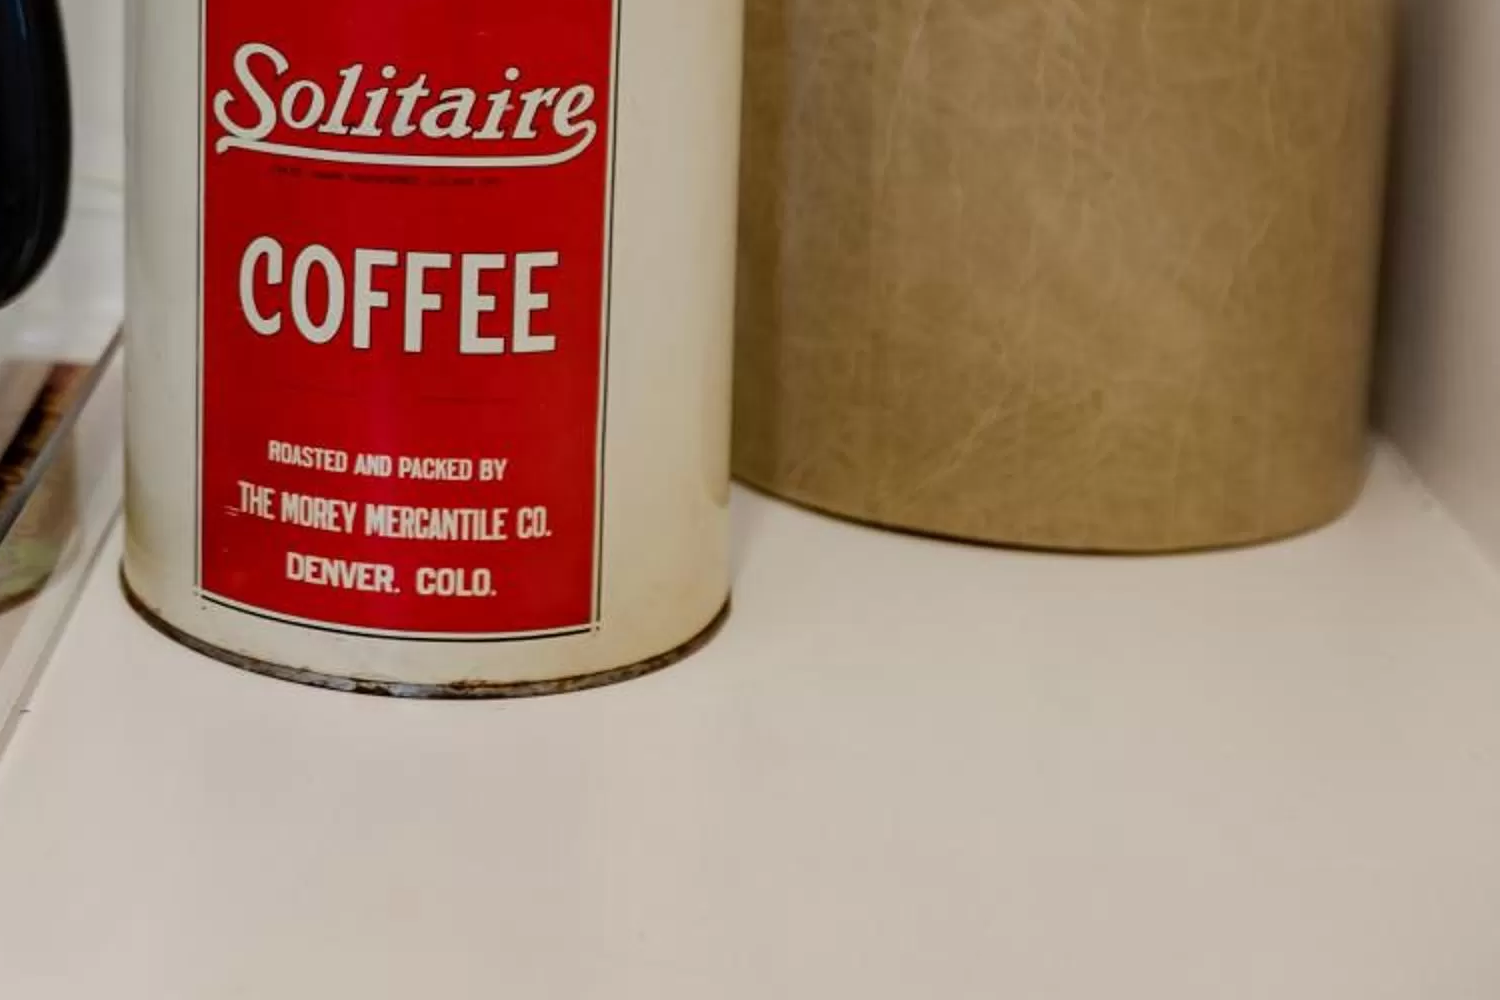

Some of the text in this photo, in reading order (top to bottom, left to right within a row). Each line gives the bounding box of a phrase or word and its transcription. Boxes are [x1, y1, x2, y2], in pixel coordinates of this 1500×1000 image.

[213, 42, 597, 167] Solitaire
[239, 235, 560, 355] COFFEE
[268, 440, 508, 482] ROASTED AND PACKED BY
[237, 480, 552, 541] THE MOREY MERCANTILE CO.
[415, 567, 498, 597] COLO.
